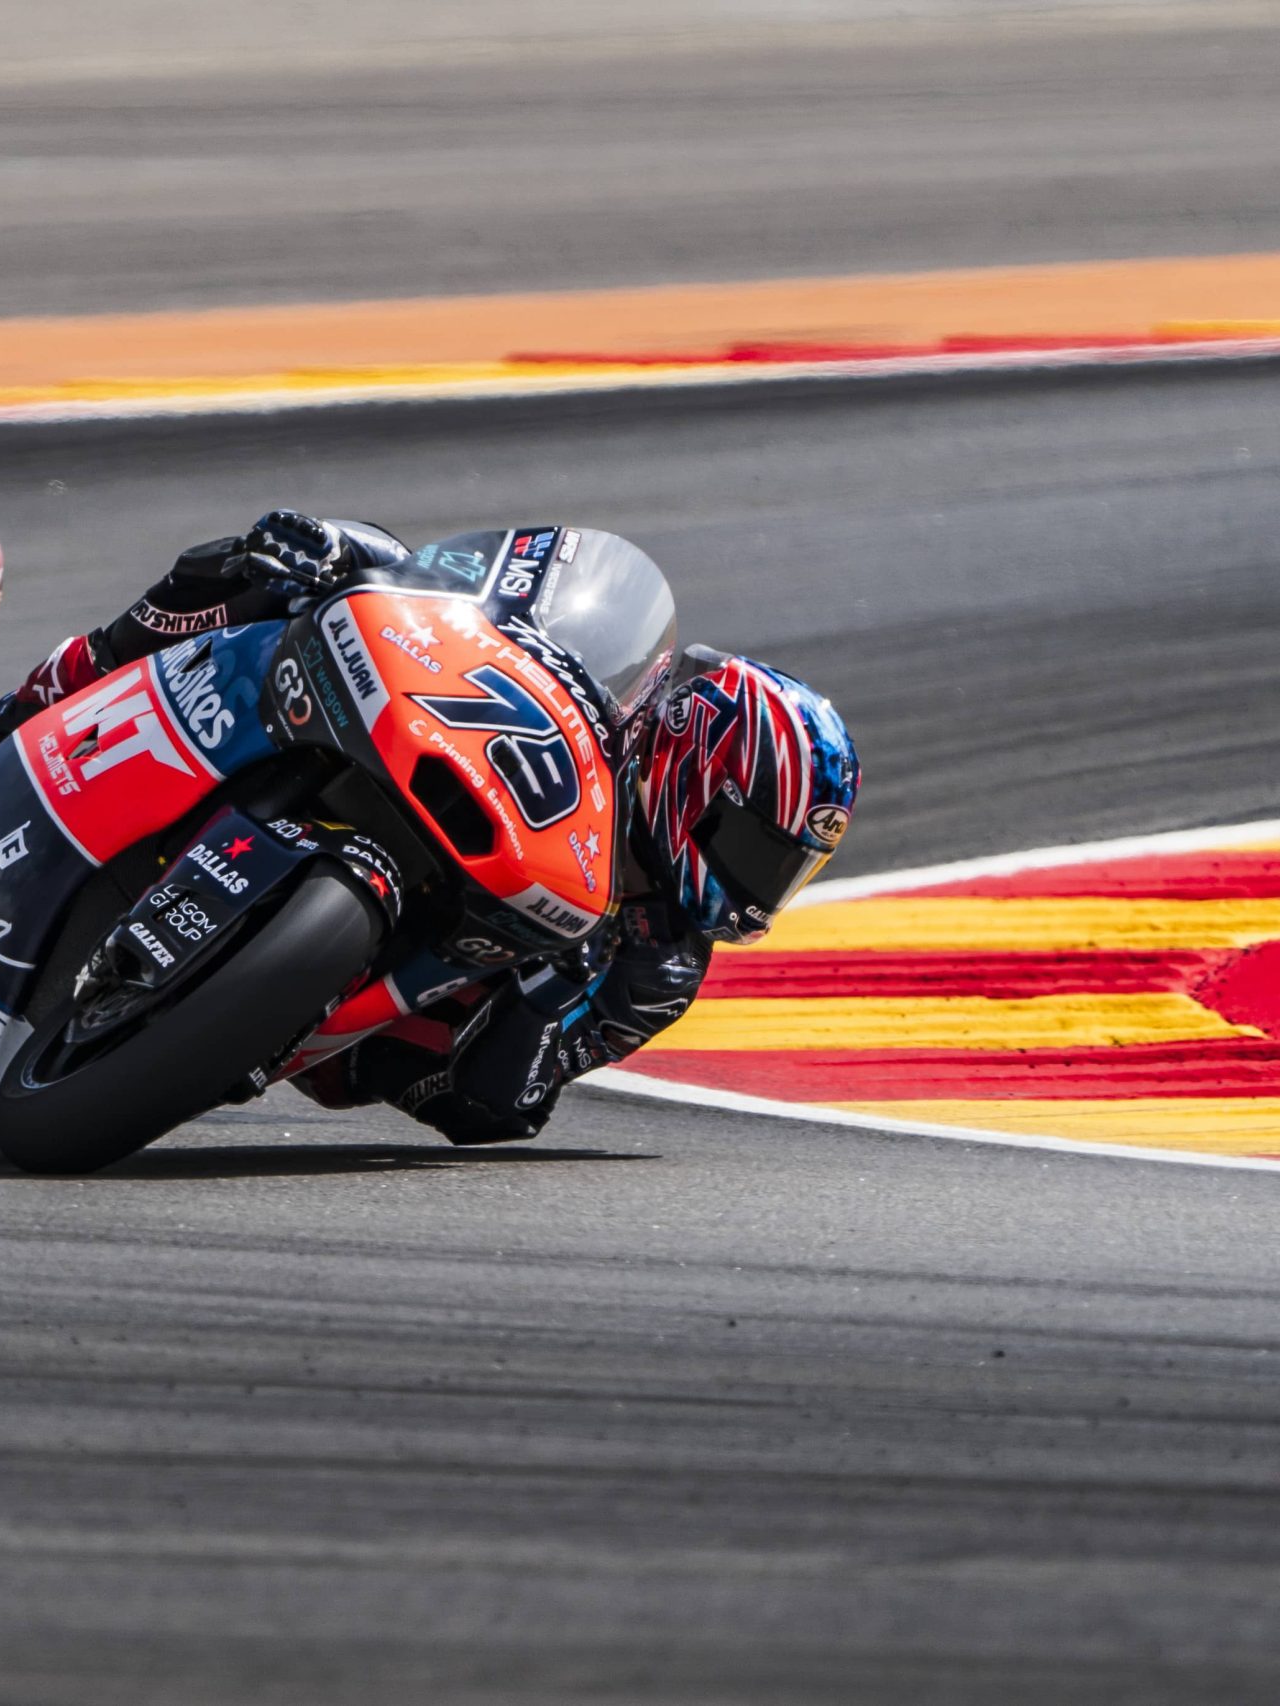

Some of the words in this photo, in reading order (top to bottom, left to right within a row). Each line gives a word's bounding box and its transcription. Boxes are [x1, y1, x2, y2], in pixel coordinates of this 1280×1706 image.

[379, 626, 443, 674] DALLAS
[275, 658, 312, 726] GRO
[318, 666, 350, 729] wegow
[61, 666, 198, 782] MT
[37, 730, 82, 797] HELMETS
[428, 730, 485, 789] Printing
[486, 787, 525, 862] Emotions
[266, 818, 303, 839] BCD
[186, 843, 250, 895] DALLAS
[568, 830, 598, 894] DALLAS
[128, 922, 175, 969] GALFER
